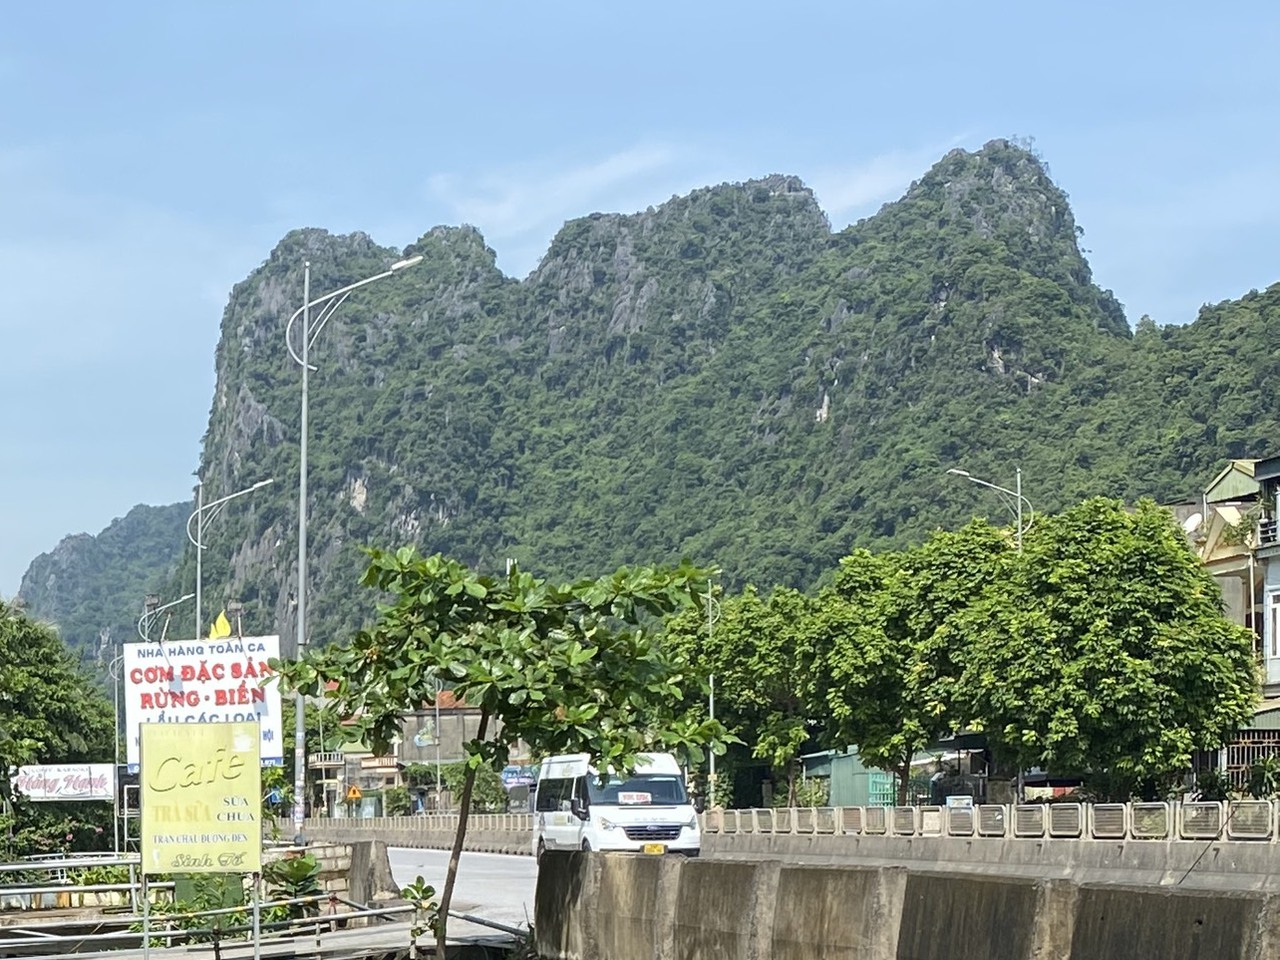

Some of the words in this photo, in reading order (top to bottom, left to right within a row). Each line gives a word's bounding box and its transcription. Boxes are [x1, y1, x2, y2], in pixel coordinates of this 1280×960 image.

[168, 645, 204, 657] HÀNG
[209, 641, 244, 654] TOÀN
[248, 643, 265, 652] CA
[130, 665, 174, 685] CƠM
[181, 659, 225, 684] ĐẶC
[140, 687, 200, 709] RỪNG
[171, 853, 214, 867] Sinh
[218, 851, 247, 866] Tố
